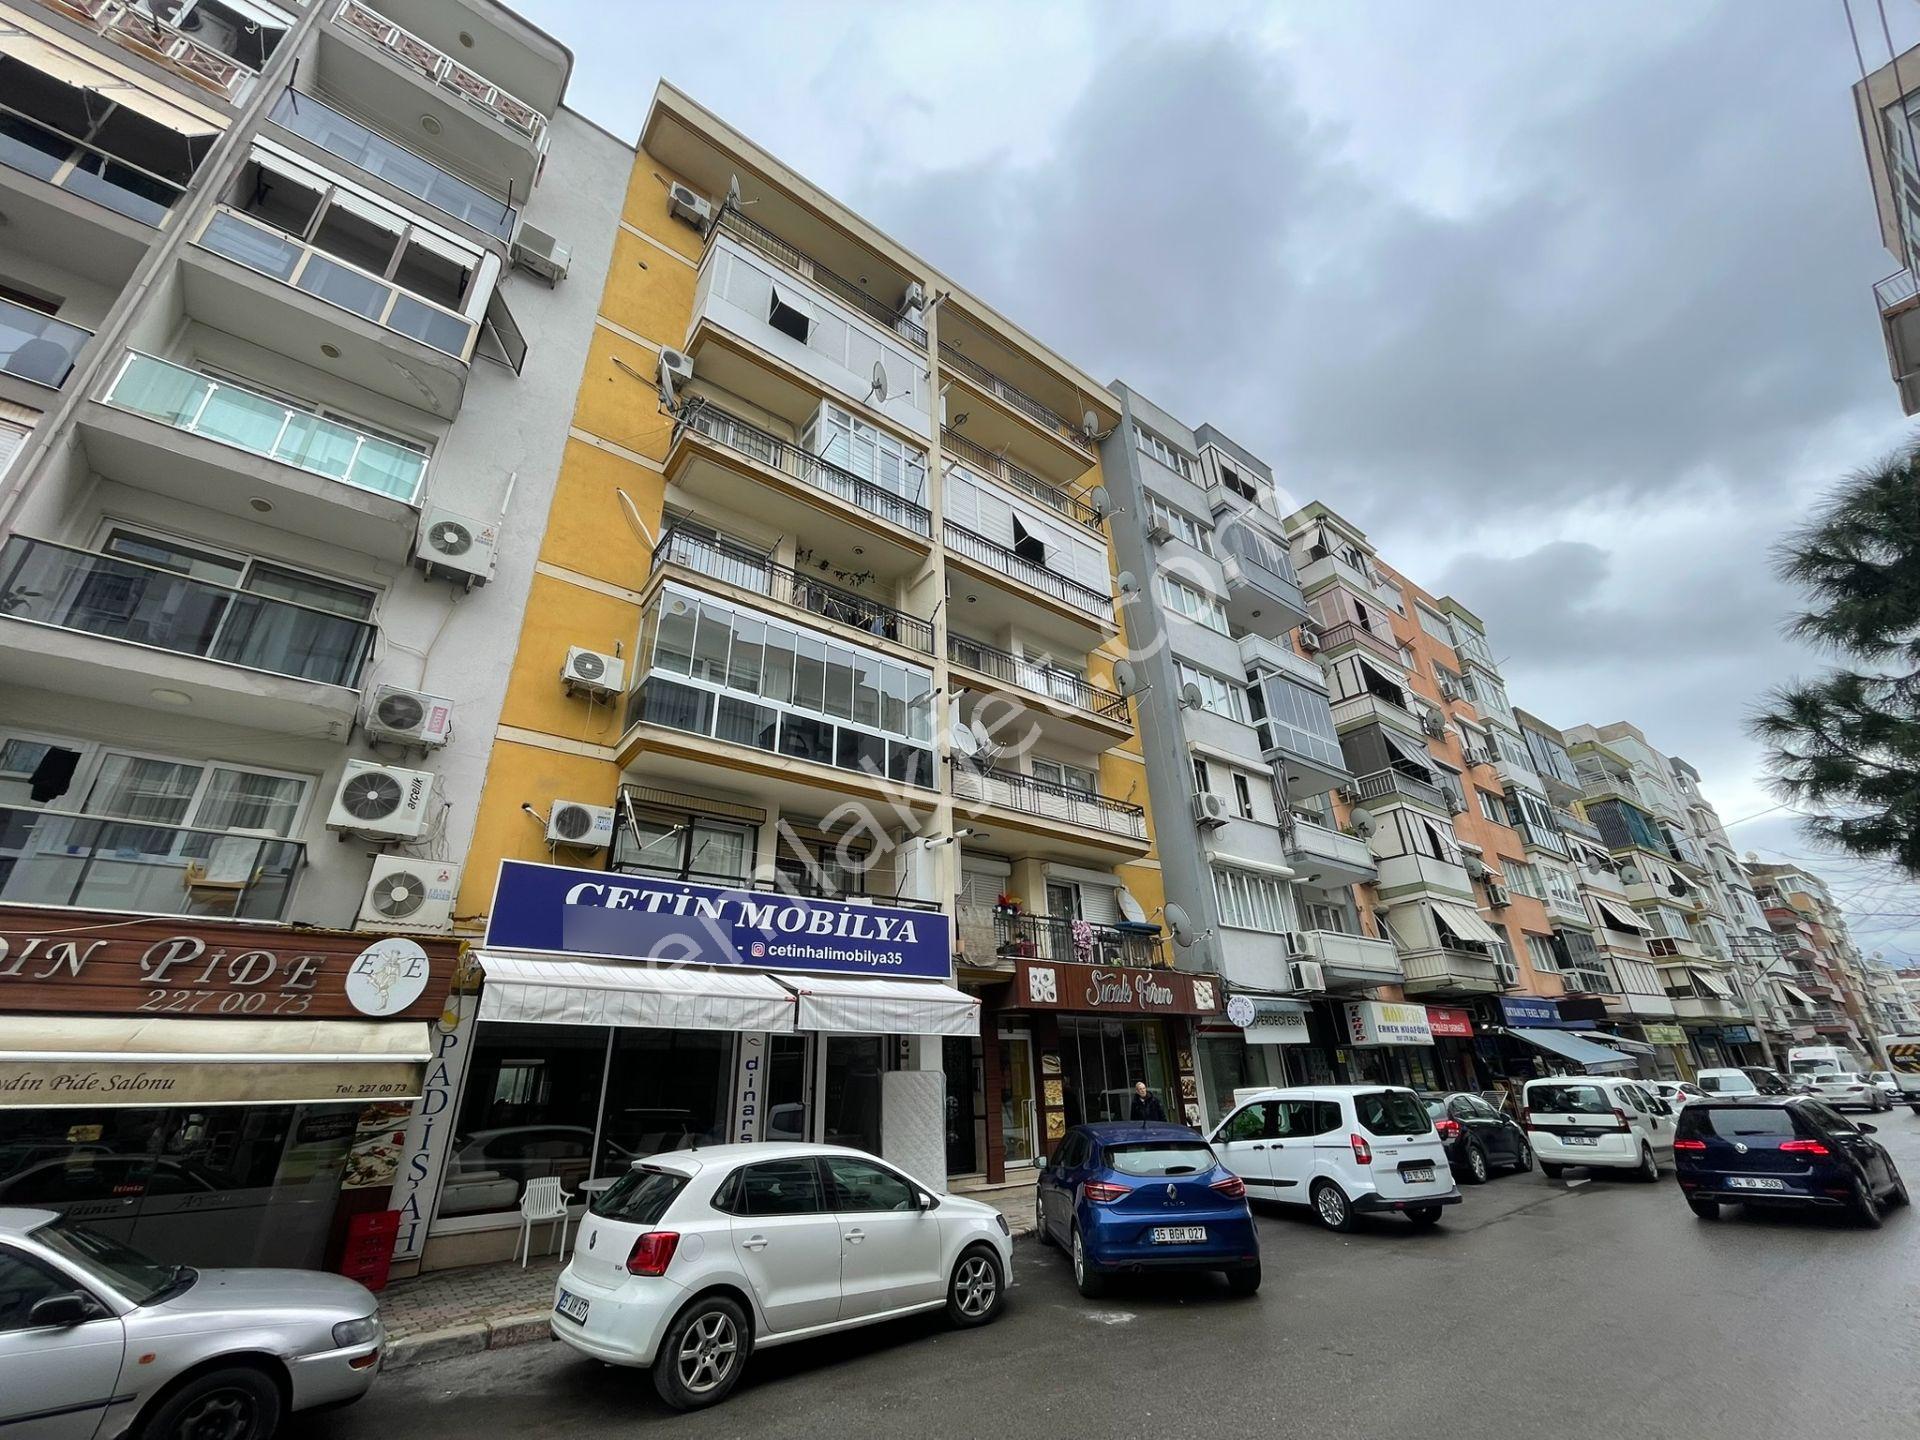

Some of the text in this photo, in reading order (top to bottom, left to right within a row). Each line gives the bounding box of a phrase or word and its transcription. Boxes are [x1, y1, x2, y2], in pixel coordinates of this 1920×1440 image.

[407, 777, 424, 810] arçelik
[735, 901, 919, 944] MOBİLYA
[139, 935, 327, 990] PİDE
[768, 943, 903, 966] cetinhalimobilya35
[137, 989, 314, 1015] 227 00 73
[50, 1072, 100, 1091] Pide
[101, 1073, 176, 1092] Salonu
[358, 1084, 378, 1093] 227
[379, 1084, 393, 1093] 00
[394, 1083, 408, 1092] 73
[1154, 1228, 1203, 1240] 35 BGH 027
